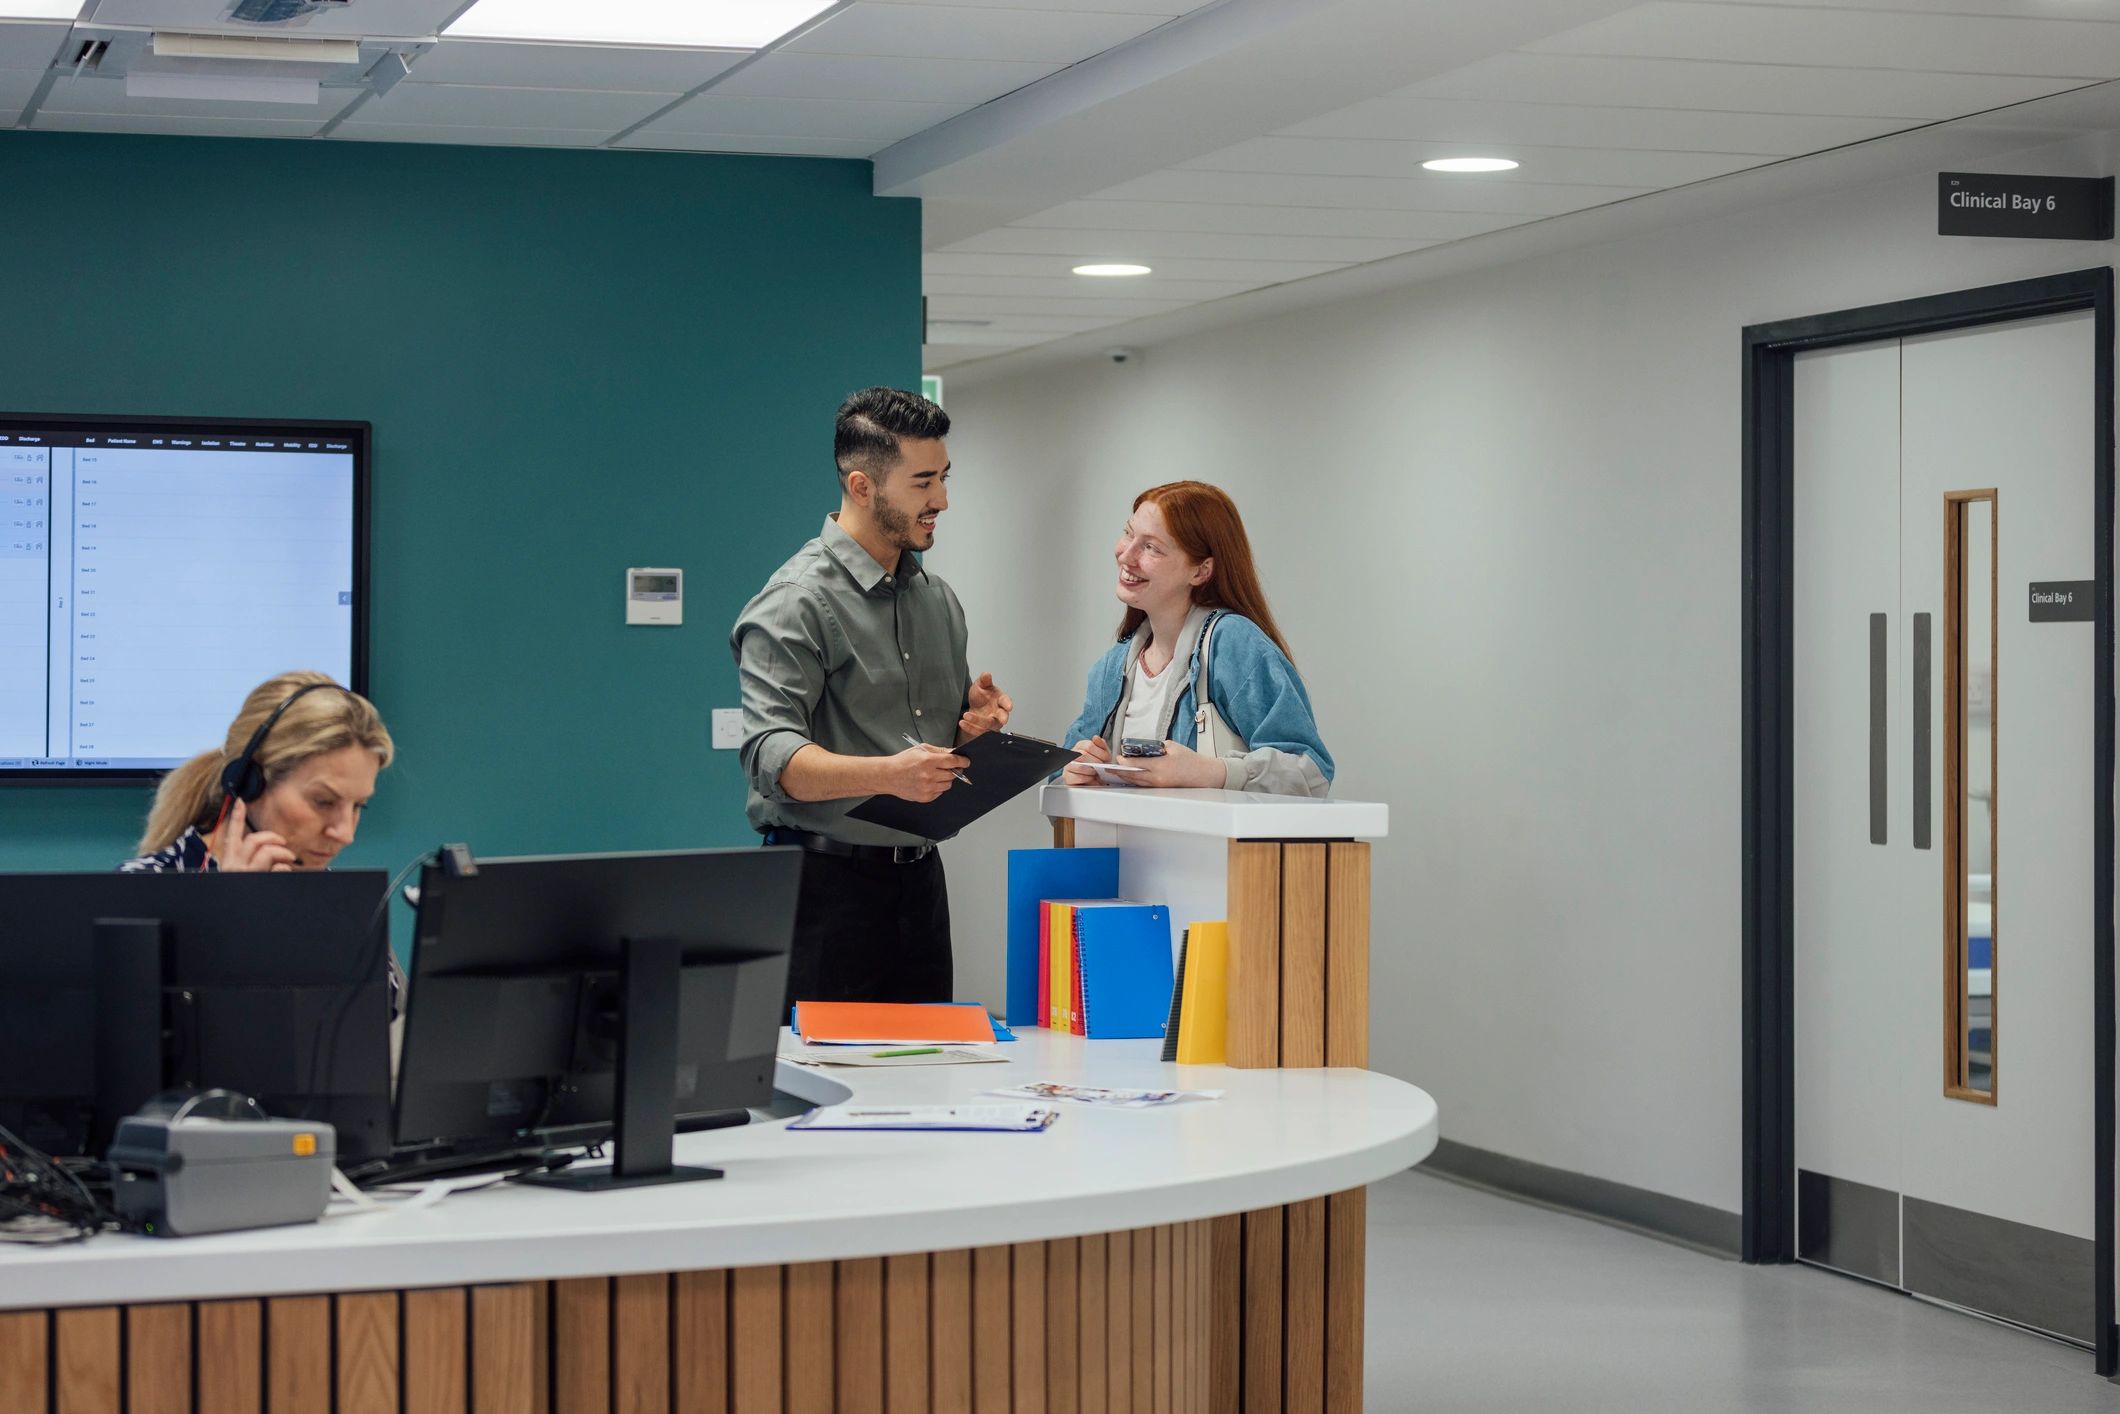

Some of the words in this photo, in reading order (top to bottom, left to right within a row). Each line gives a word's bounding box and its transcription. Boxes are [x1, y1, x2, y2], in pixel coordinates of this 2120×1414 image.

[1950, 191, 2006, 209] Clinical
[2012, 194, 2042, 214] Bay
[2045, 195, 2056, 211] 6
[2031, 591, 2054, 604] Clinical
[2054, 592, 2067, 606] Bay
[2067, 591, 2073, 603] 6
